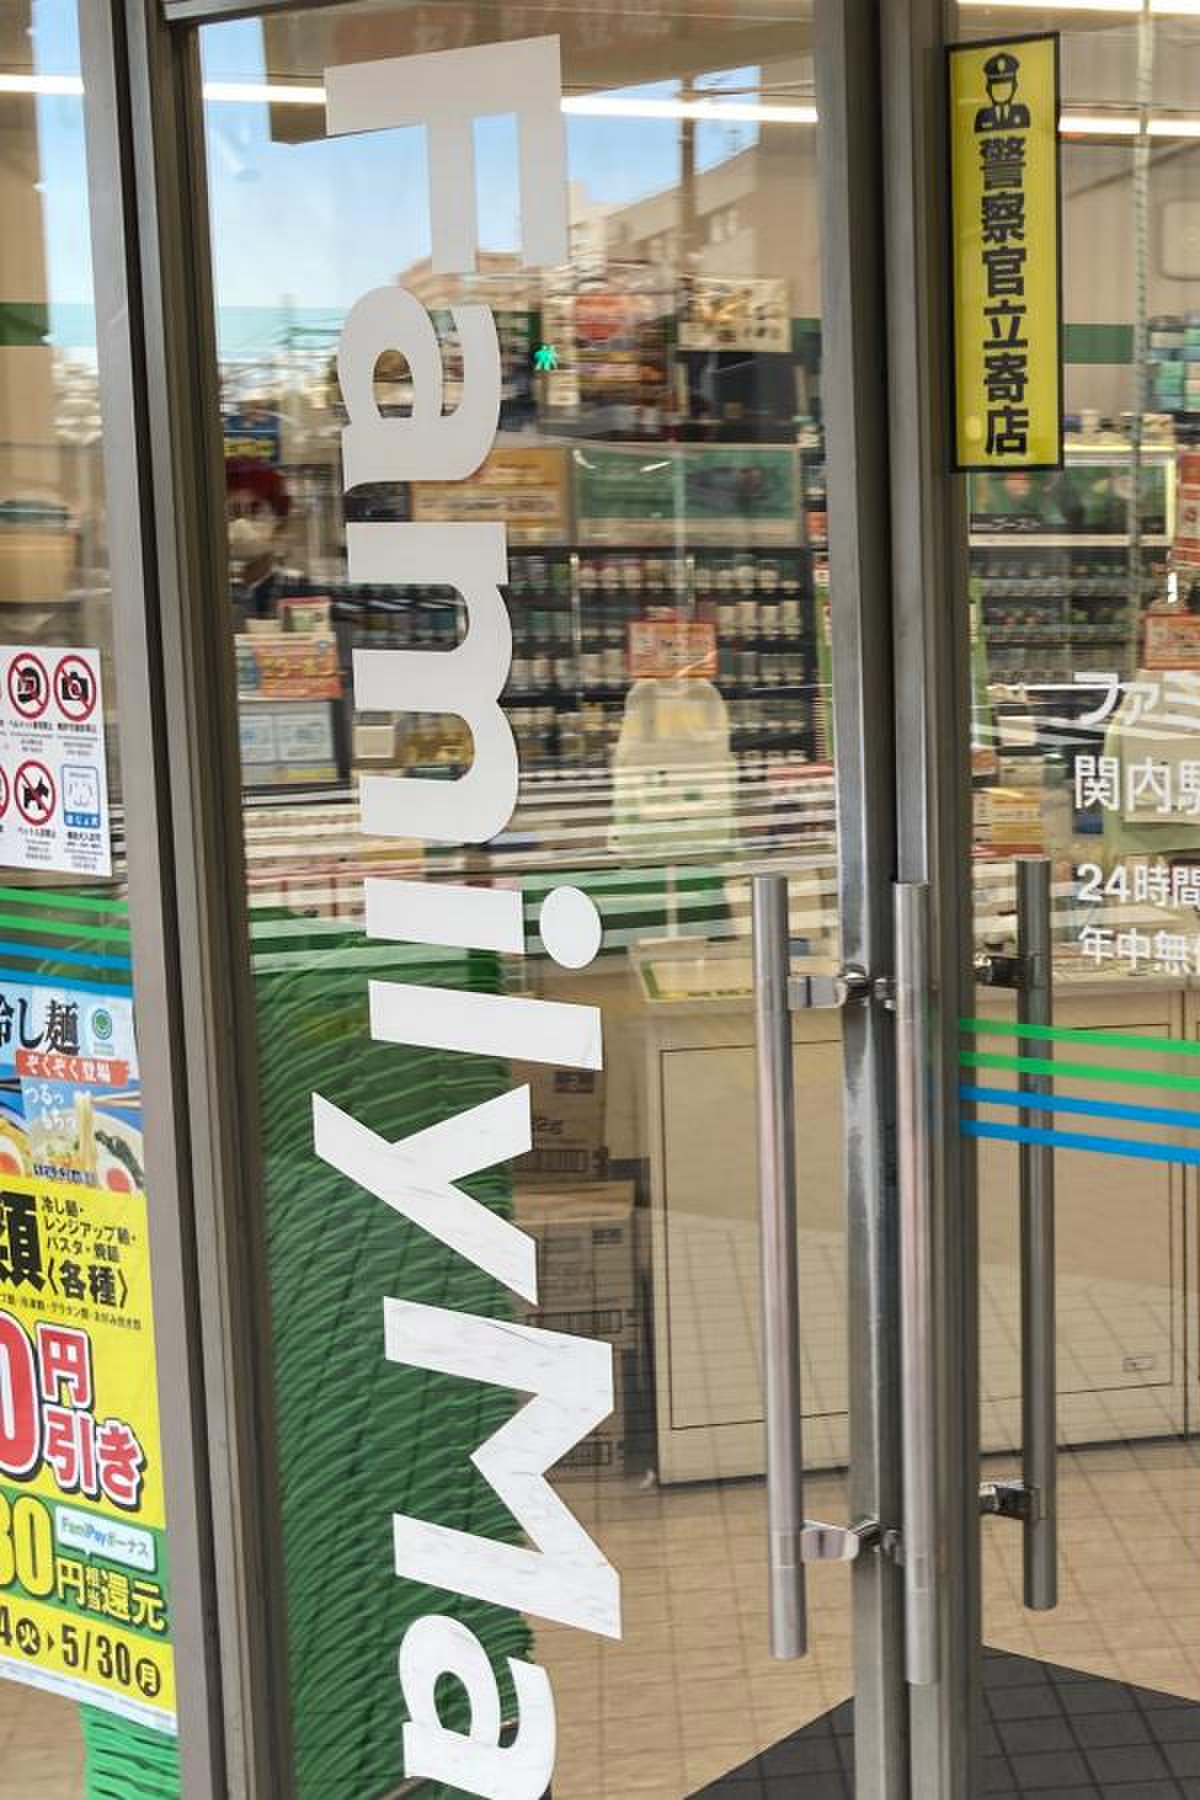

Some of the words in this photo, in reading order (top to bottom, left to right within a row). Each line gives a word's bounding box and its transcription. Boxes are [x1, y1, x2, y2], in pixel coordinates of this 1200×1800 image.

[979, 137, 1030, 458] 警察官立寄店
